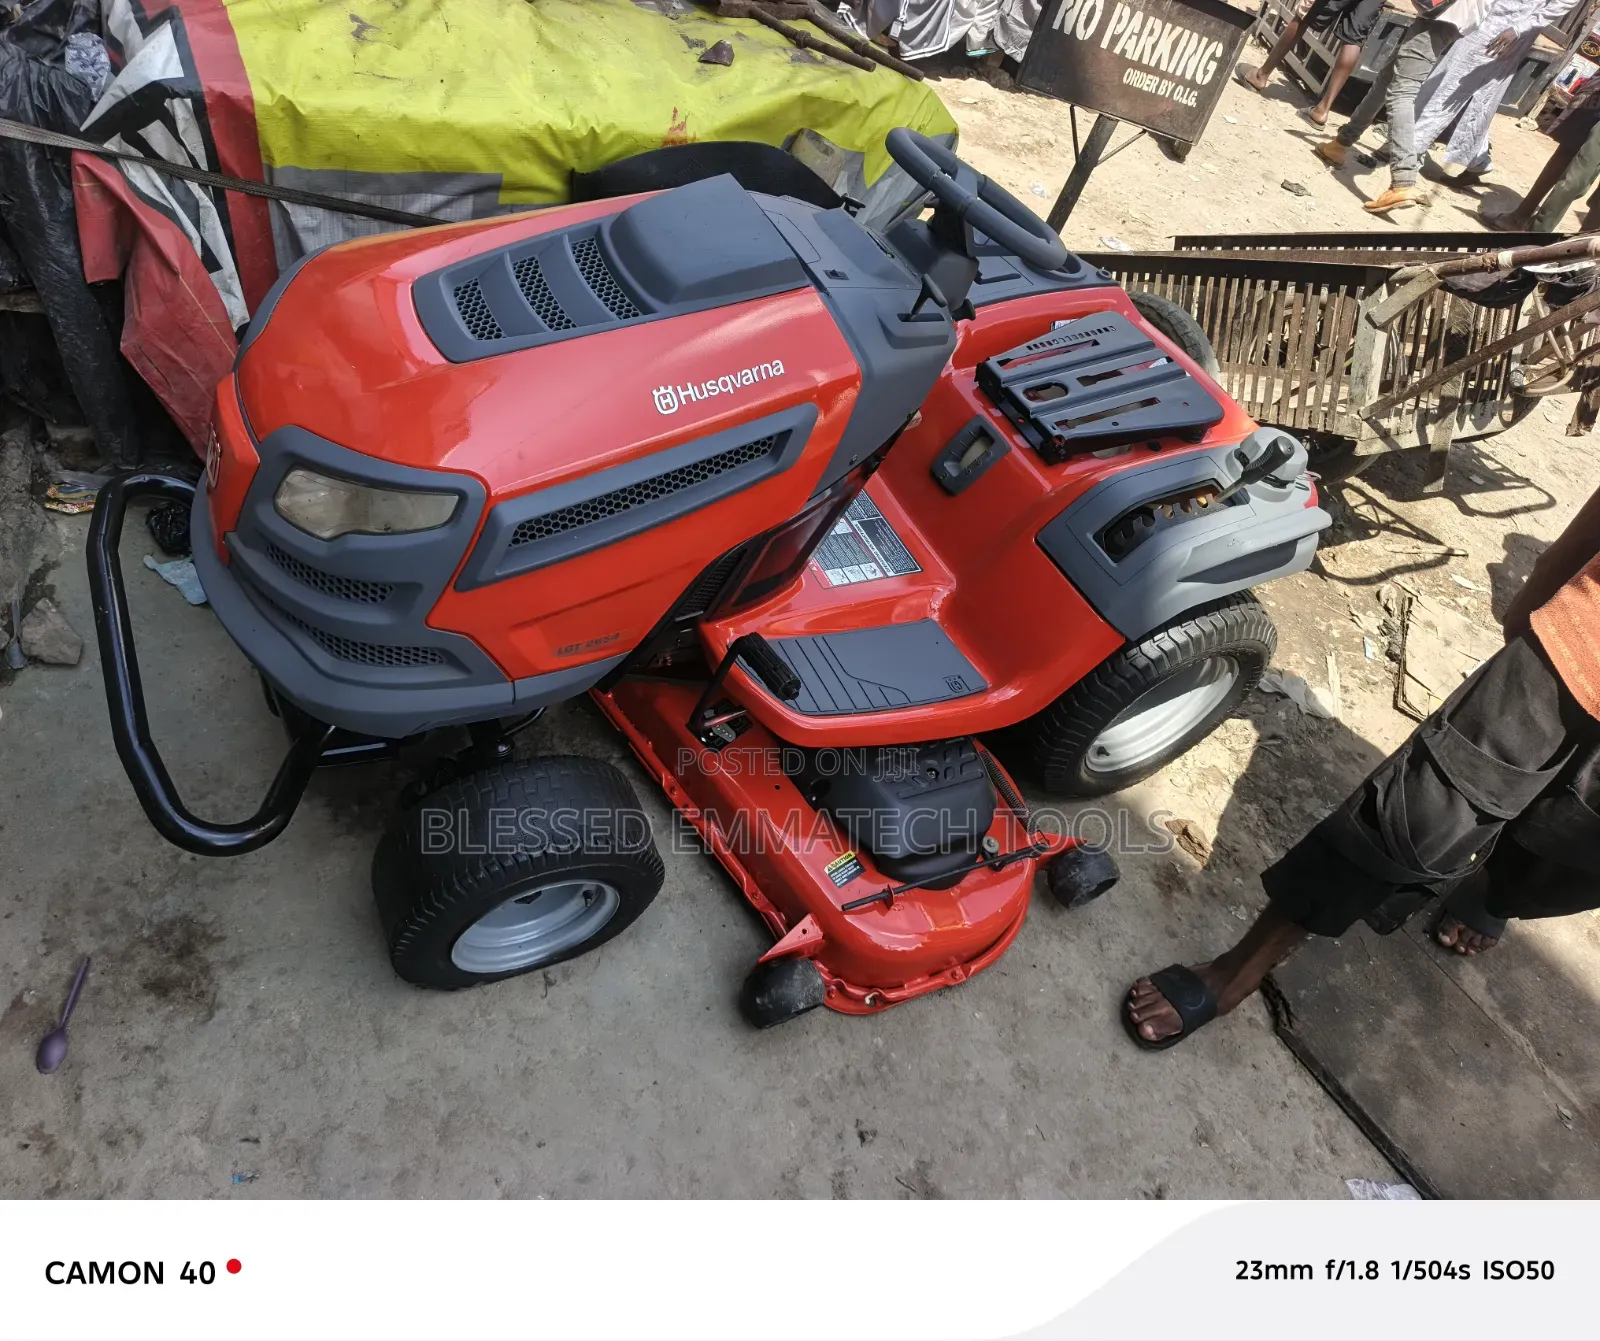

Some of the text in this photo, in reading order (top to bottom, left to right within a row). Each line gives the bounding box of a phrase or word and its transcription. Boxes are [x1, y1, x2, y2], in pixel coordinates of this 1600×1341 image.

[1052, 0, 1223, 86] NO PARKING
[1123, 67, 1160, 93] ORDER
[1157, 79, 1176, 97] BY
[676, 360, 785, 405] Husqvarna
[557, 632, 620, 656] LGT 2654
[831, 853, 853, 868] CAUTION
